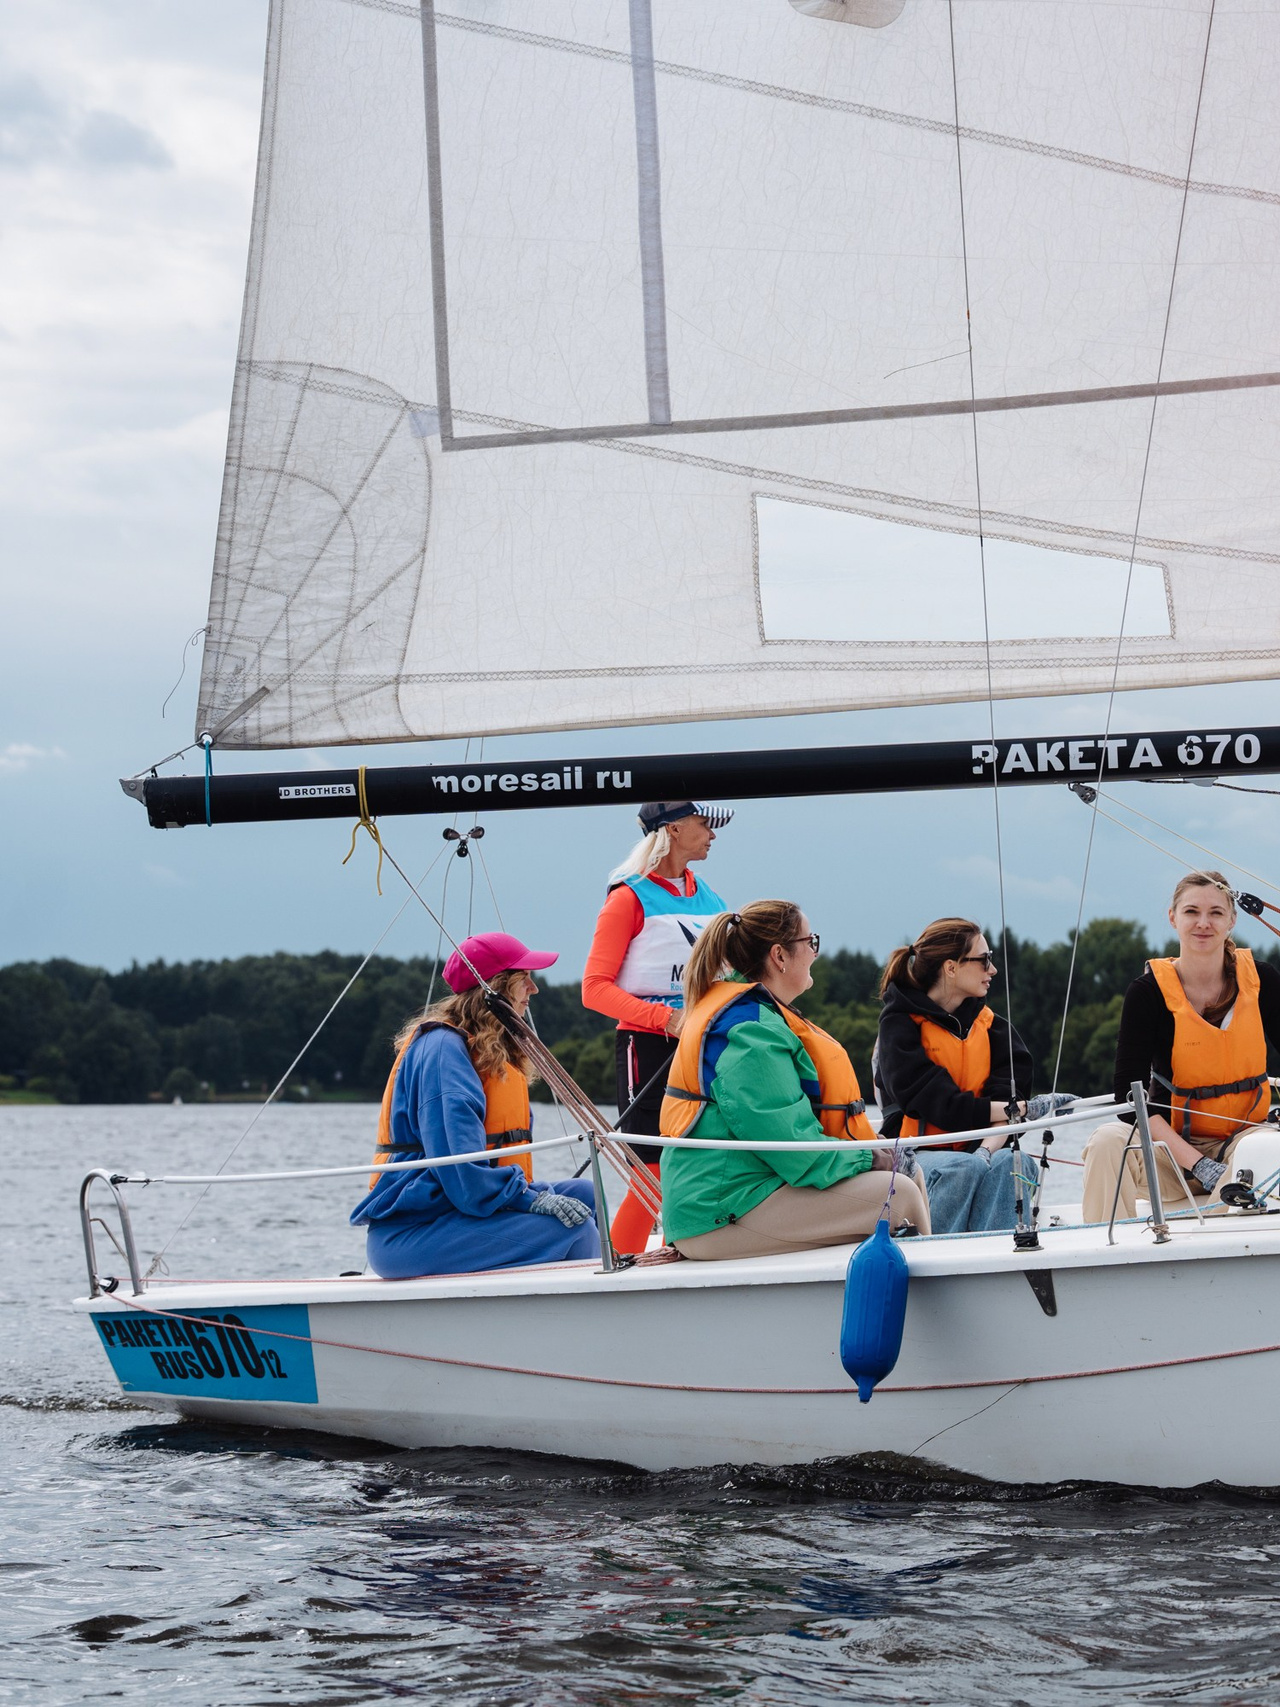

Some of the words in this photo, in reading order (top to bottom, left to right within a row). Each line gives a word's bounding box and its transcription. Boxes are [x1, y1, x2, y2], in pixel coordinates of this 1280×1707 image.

[1176, 733, 1261, 767] 670
[294, 786, 351, 796] BROTHERS
[596, 770, 632, 789] ru
[182, 1313, 266, 1379] 670
[150, 1351, 205, 1380] RUS
[260, 1349, 288, 1379] 12
